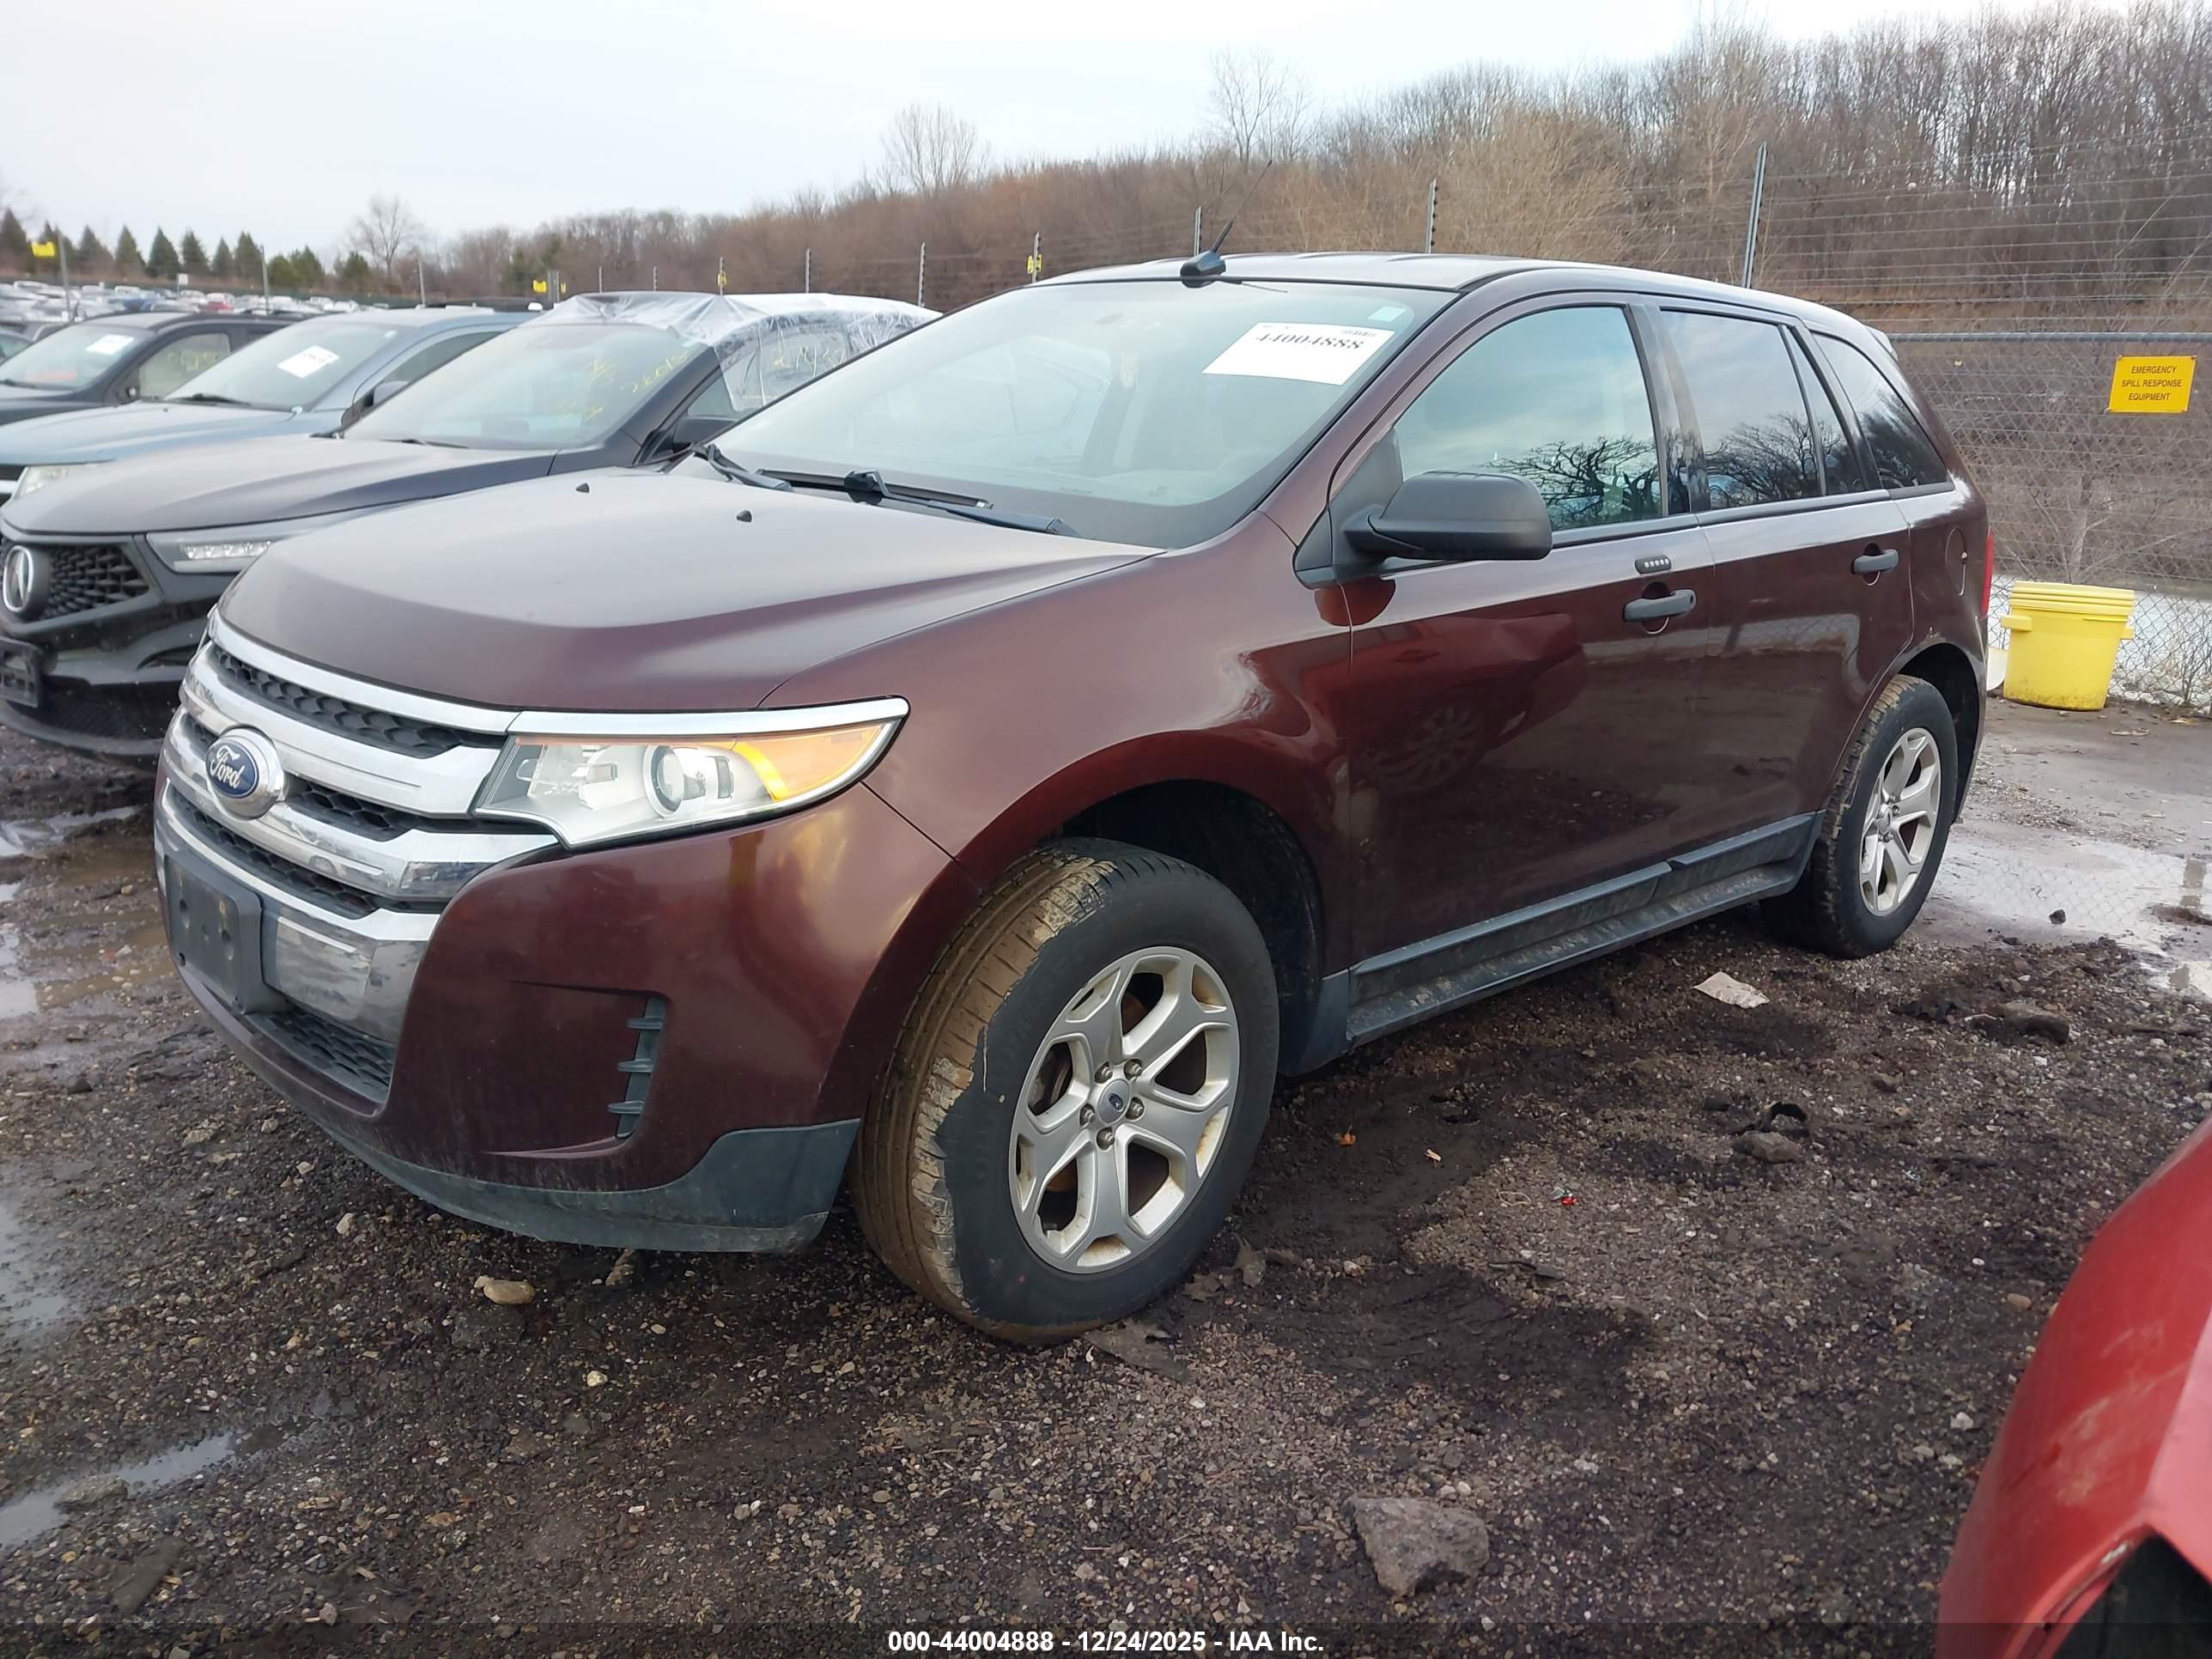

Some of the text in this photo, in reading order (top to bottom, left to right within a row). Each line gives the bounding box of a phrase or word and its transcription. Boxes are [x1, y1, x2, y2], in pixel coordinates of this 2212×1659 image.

[2131, 366, 2177, 374] EMERGENCY
[2121, 379, 2182, 387] SPILL RESPONSE
[2128, 392, 2171, 401] EQUIPMENT
[210, 744, 246, 789] Ford
